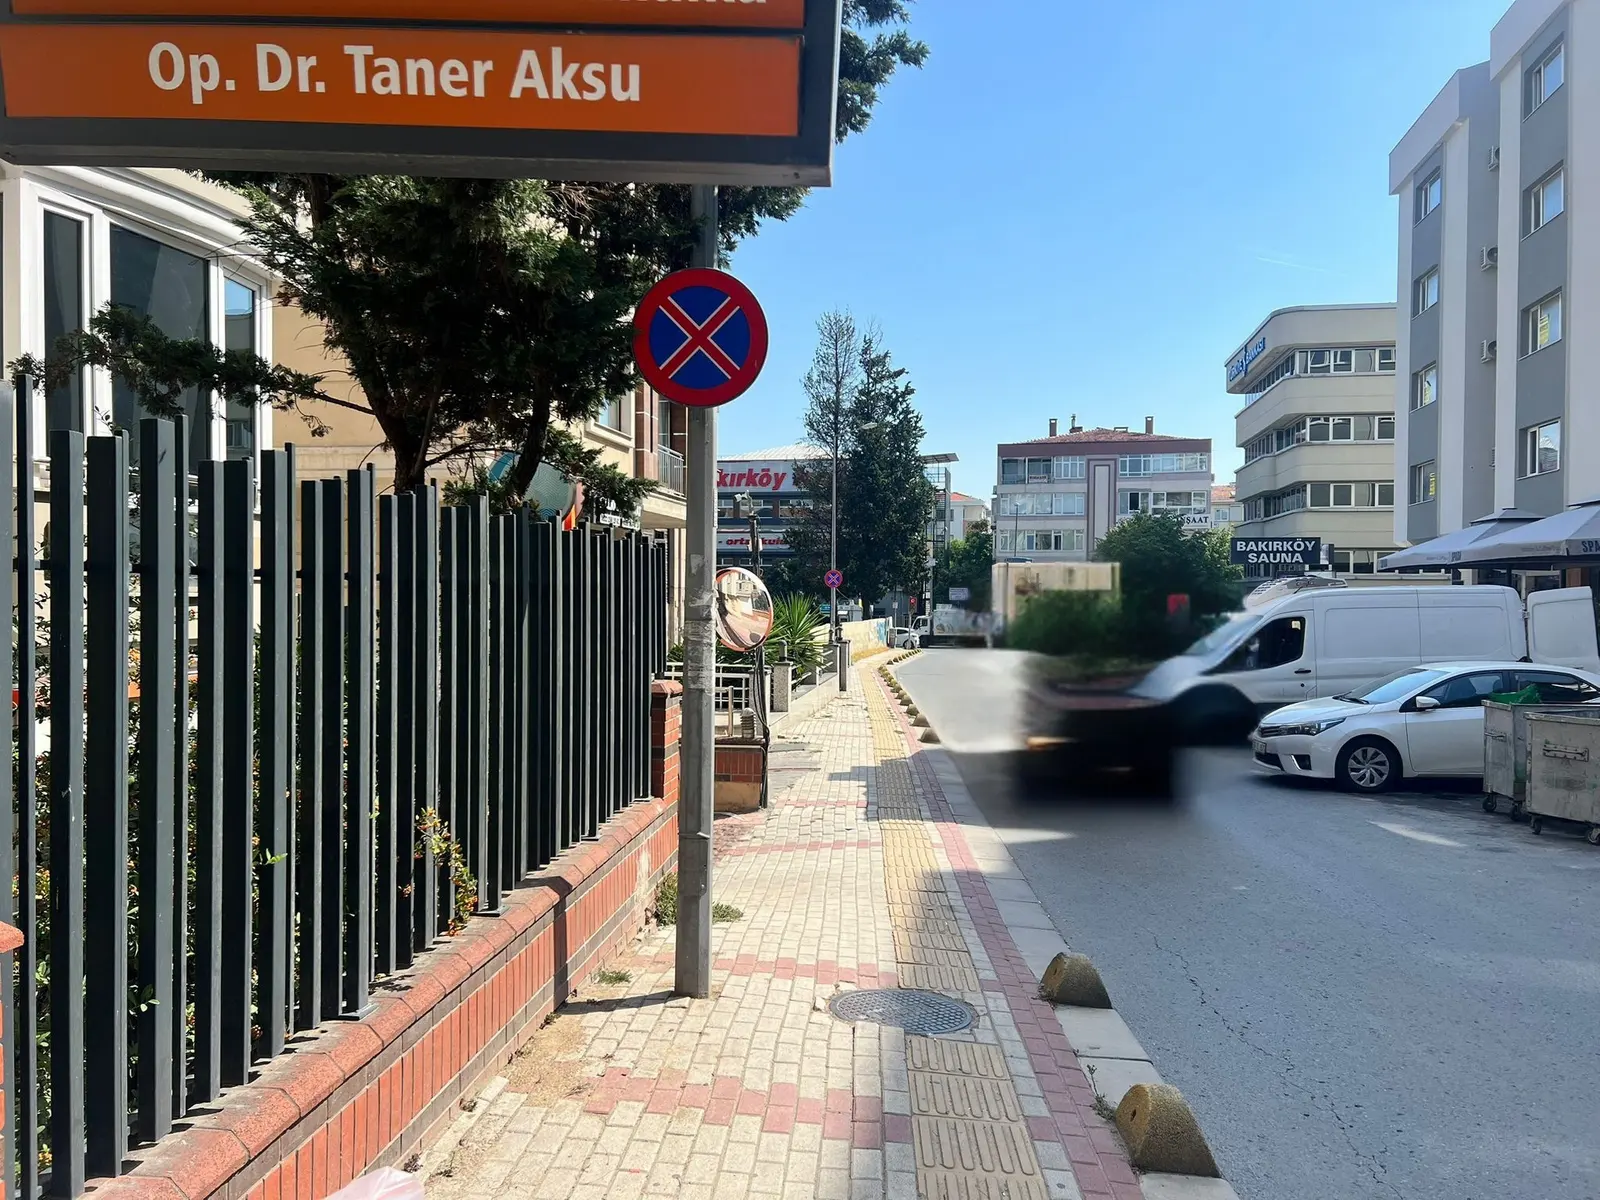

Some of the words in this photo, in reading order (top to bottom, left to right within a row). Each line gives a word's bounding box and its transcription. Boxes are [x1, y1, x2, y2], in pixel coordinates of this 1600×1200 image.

[149, 42, 236, 104] Op.
[256, 43, 326, 93] Dr.
[344, 45, 494, 98] Taner
[510, 47, 640, 102] Aksu
[1236, 538, 1316, 551] BAKIRKÖY
[1247, 553, 1304, 563] SAUNA
